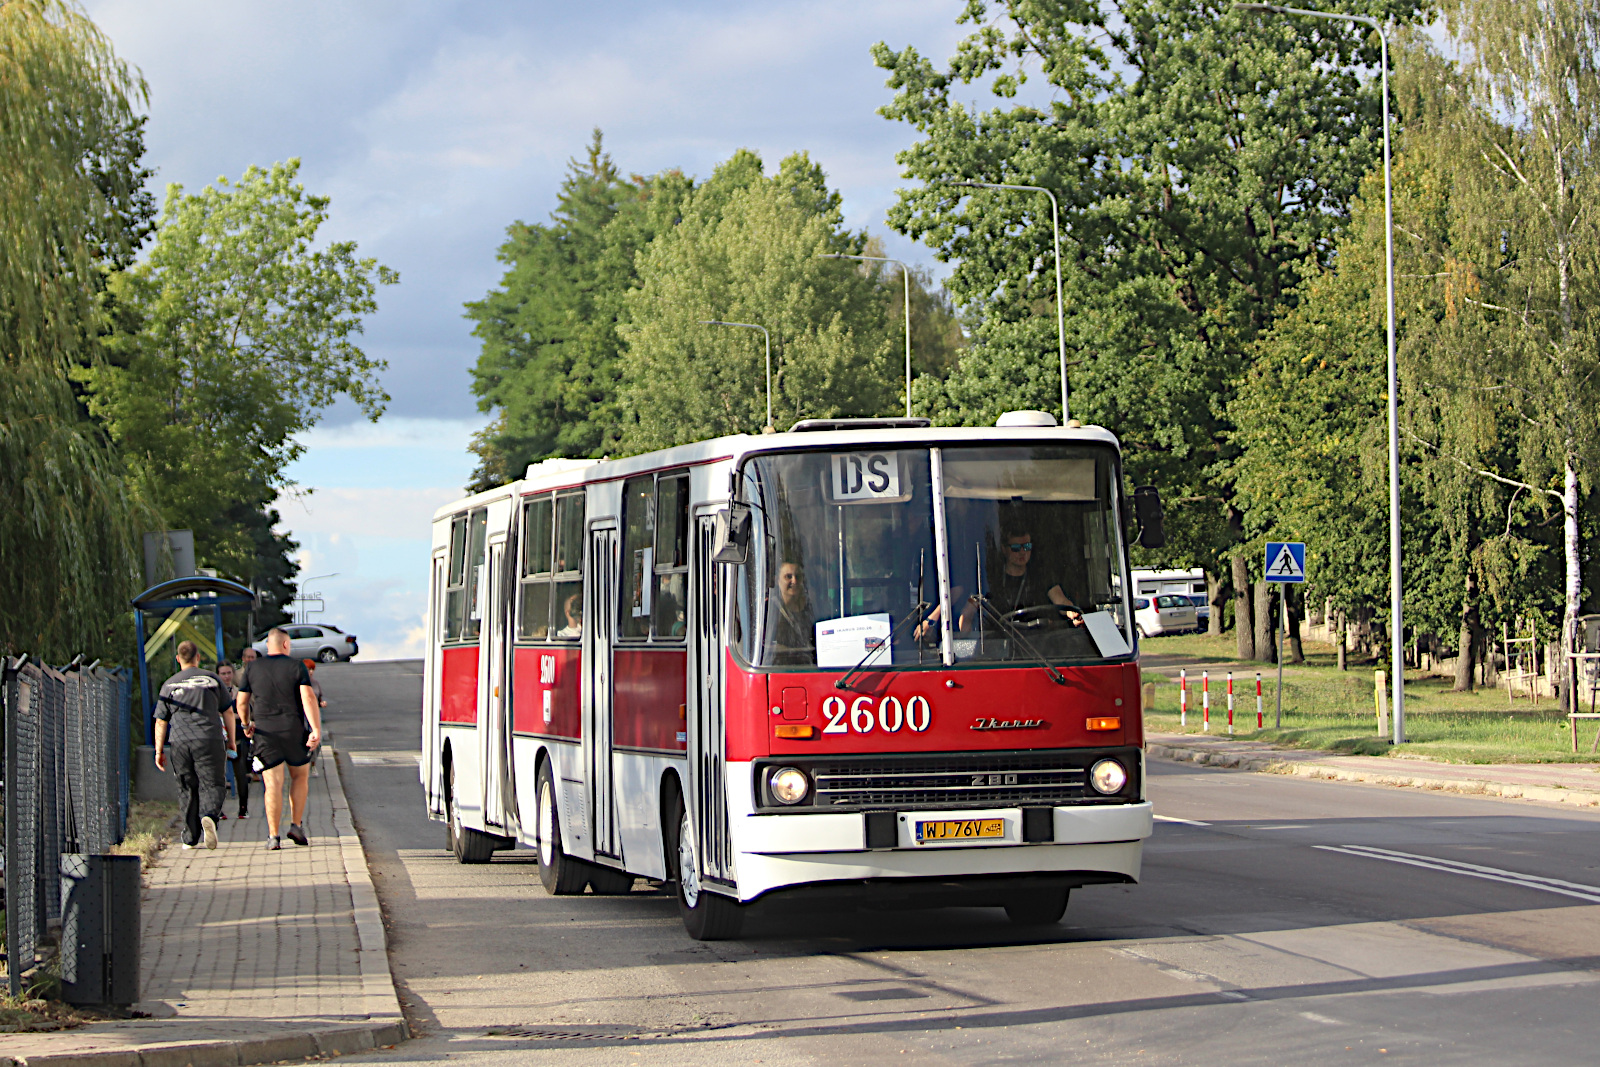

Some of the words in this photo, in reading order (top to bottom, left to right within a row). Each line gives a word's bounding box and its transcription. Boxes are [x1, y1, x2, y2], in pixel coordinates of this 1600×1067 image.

[840, 454, 890, 494] DS
[541, 655, 555, 683] 2600
[822, 696, 932, 734] 2600
[970, 718, 1043, 729] Ikarus
[972, 774, 1018, 786] 280
[926, 822, 947, 838] WJ
[953, 821, 982, 837] 76V
